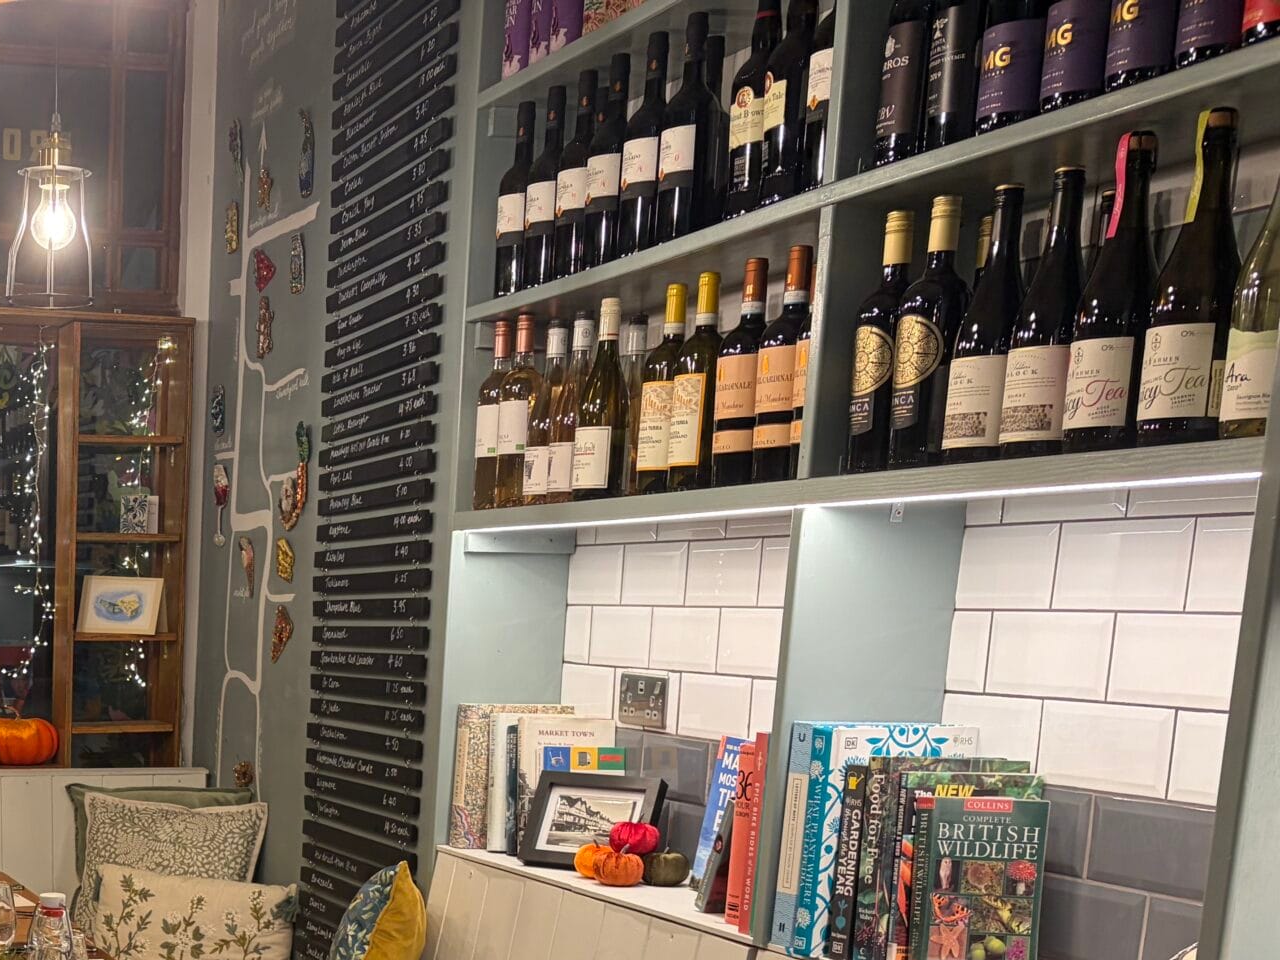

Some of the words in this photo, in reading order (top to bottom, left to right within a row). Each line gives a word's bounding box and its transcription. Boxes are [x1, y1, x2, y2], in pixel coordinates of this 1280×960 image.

[1159, 366, 1206, 396] Tea
[1225, 362, 1252, 384] Ara
[1082, 378, 1127, 407] Tea
[538, 729, 568, 737] MARKET
[570, 729, 595, 738] TOWN
[959, 737, 973, 745] RHS
[718, 772, 737, 787] MOS
[934, 784, 975, 798] NEW
[814, 785, 822, 820] WHAT
[850, 799, 862, 807] RHS
[870, 774, 885, 815] Food
[967, 801, 1010, 810] COLLINS
[868, 818, 881, 846] for
[937, 822, 1041, 843] BRITISH
[963, 815, 1012, 823] COMPLETE
[748, 830, 756, 857] RIDES
[808, 822, 819, 860] PLANT
[844, 809, 862, 897] GARDENING
[918, 813, 928, 866] BRITISH
[936, 841, 1039, 860] WILDLIFE
[835, 858, 847, 895] YEAR
[864, 848, 879, 884] Free
[744, 878, 752, 911] WORLD
[803, 863, 814, 905] WHERE
